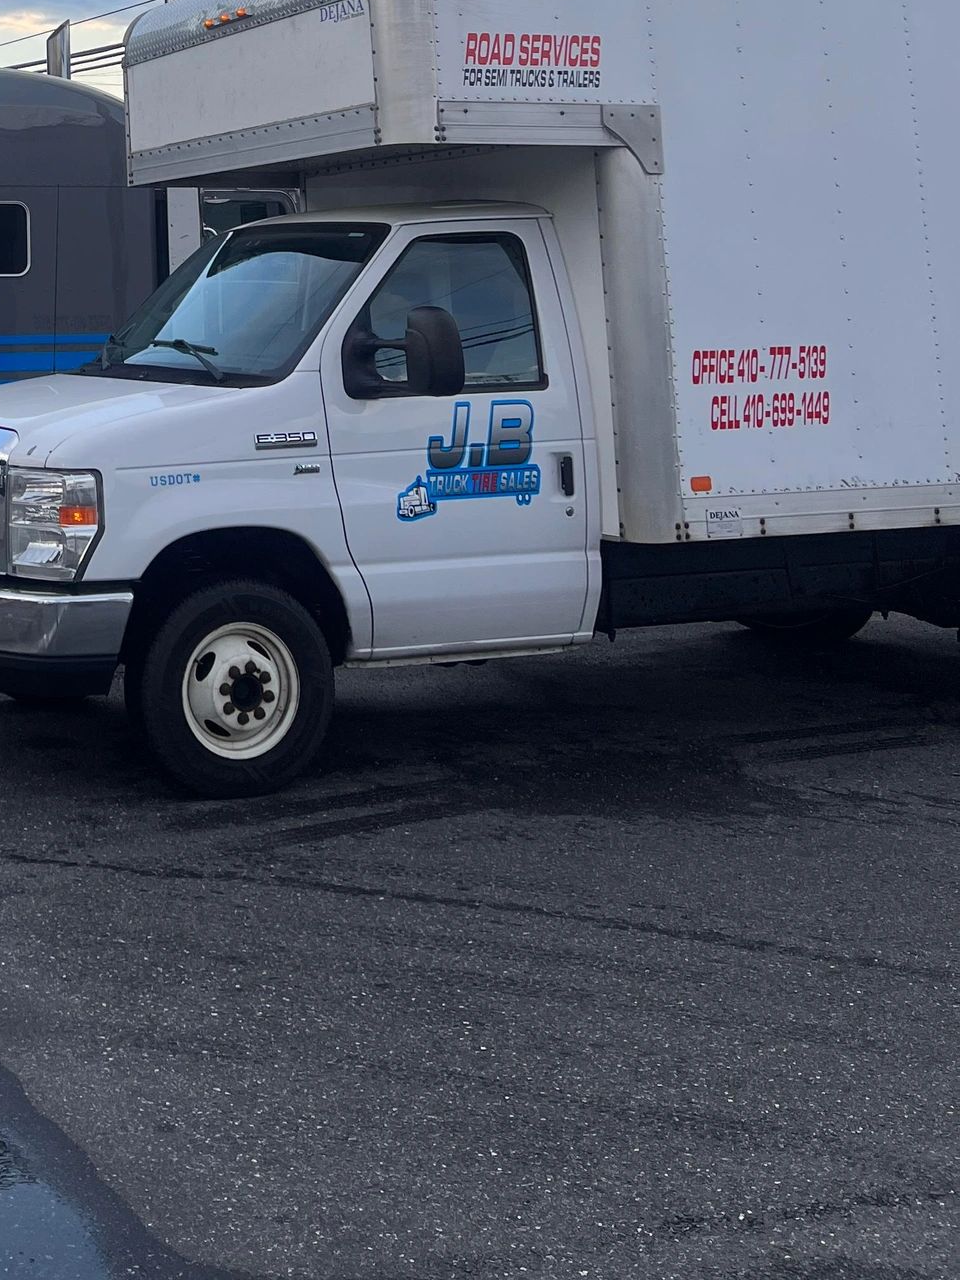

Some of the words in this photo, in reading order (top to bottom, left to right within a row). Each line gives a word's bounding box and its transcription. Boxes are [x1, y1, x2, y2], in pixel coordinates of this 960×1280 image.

[465, 32, 515, 66] ROAD
[518, 33, 601, 68] SERVICES
[463, 68, 482, 86] FOR
[484, 68, 508, 87] SEMI
[510, 69, 546, 87] TRUCKS
[548, 70, 555, 88] &
[557, 70, 601, 89] TRAILERS
[692, 350, 735, 385] OFFICE
[711, 395, 740, 431] CELL
[743, 391, 830, 429] 410-699-1449
[150, 473, 201, 487] USDOT#
[429, 474, 469, 494] TRUCK
[471, 472, 499, 493] TIRE
[500, 470, 538, 491] SALES
[709, 511, 740, 520] DEJANA
